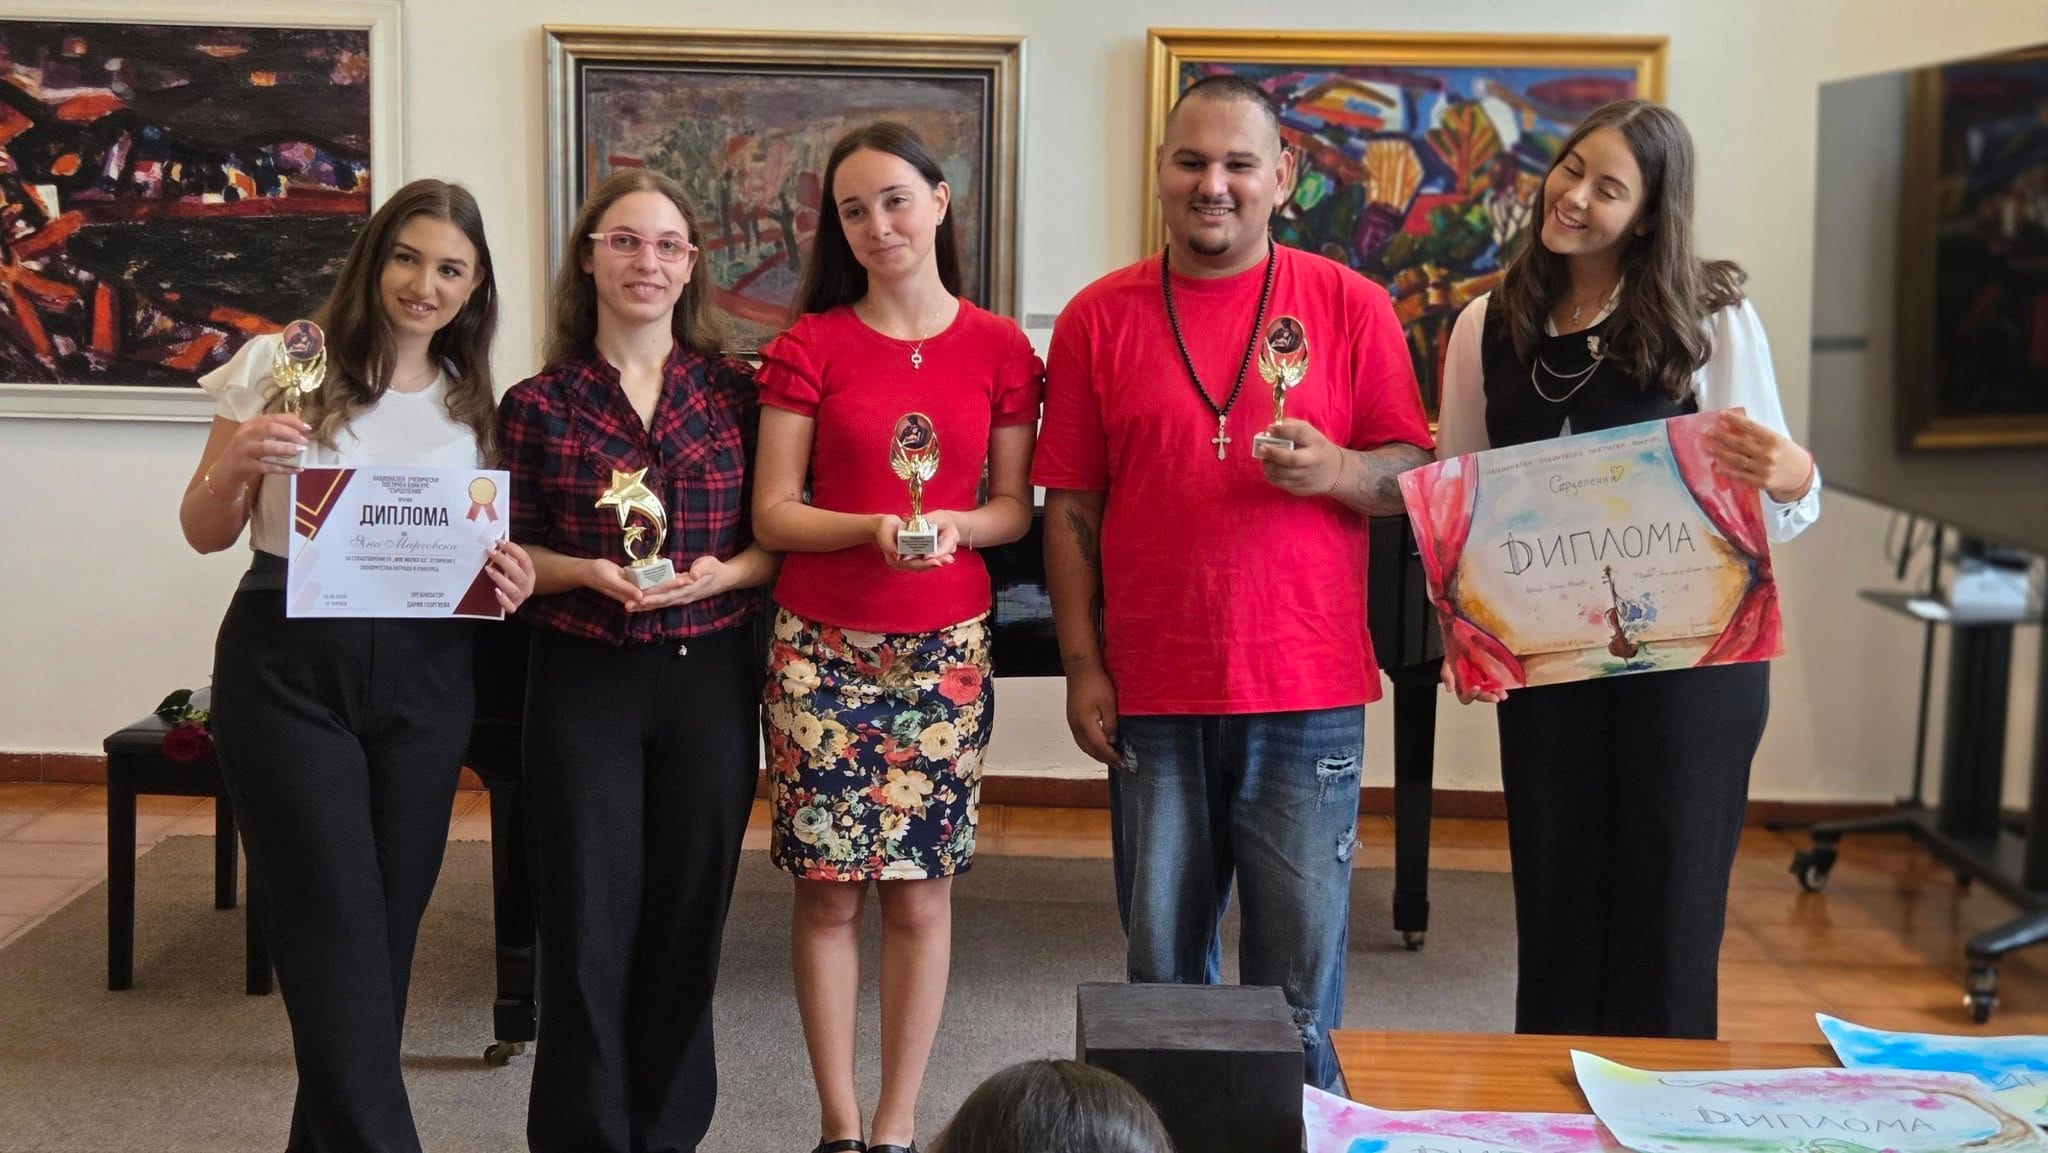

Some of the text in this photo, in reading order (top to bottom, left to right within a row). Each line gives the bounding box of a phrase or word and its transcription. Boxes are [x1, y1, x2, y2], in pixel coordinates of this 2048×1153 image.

[359, 504, 450, 527] ДИПЛОМА
[1498, 521, 1696, 576] ДИПЛОМА
[1690, 1105, 1937, 1133] ДИПЛОМА
